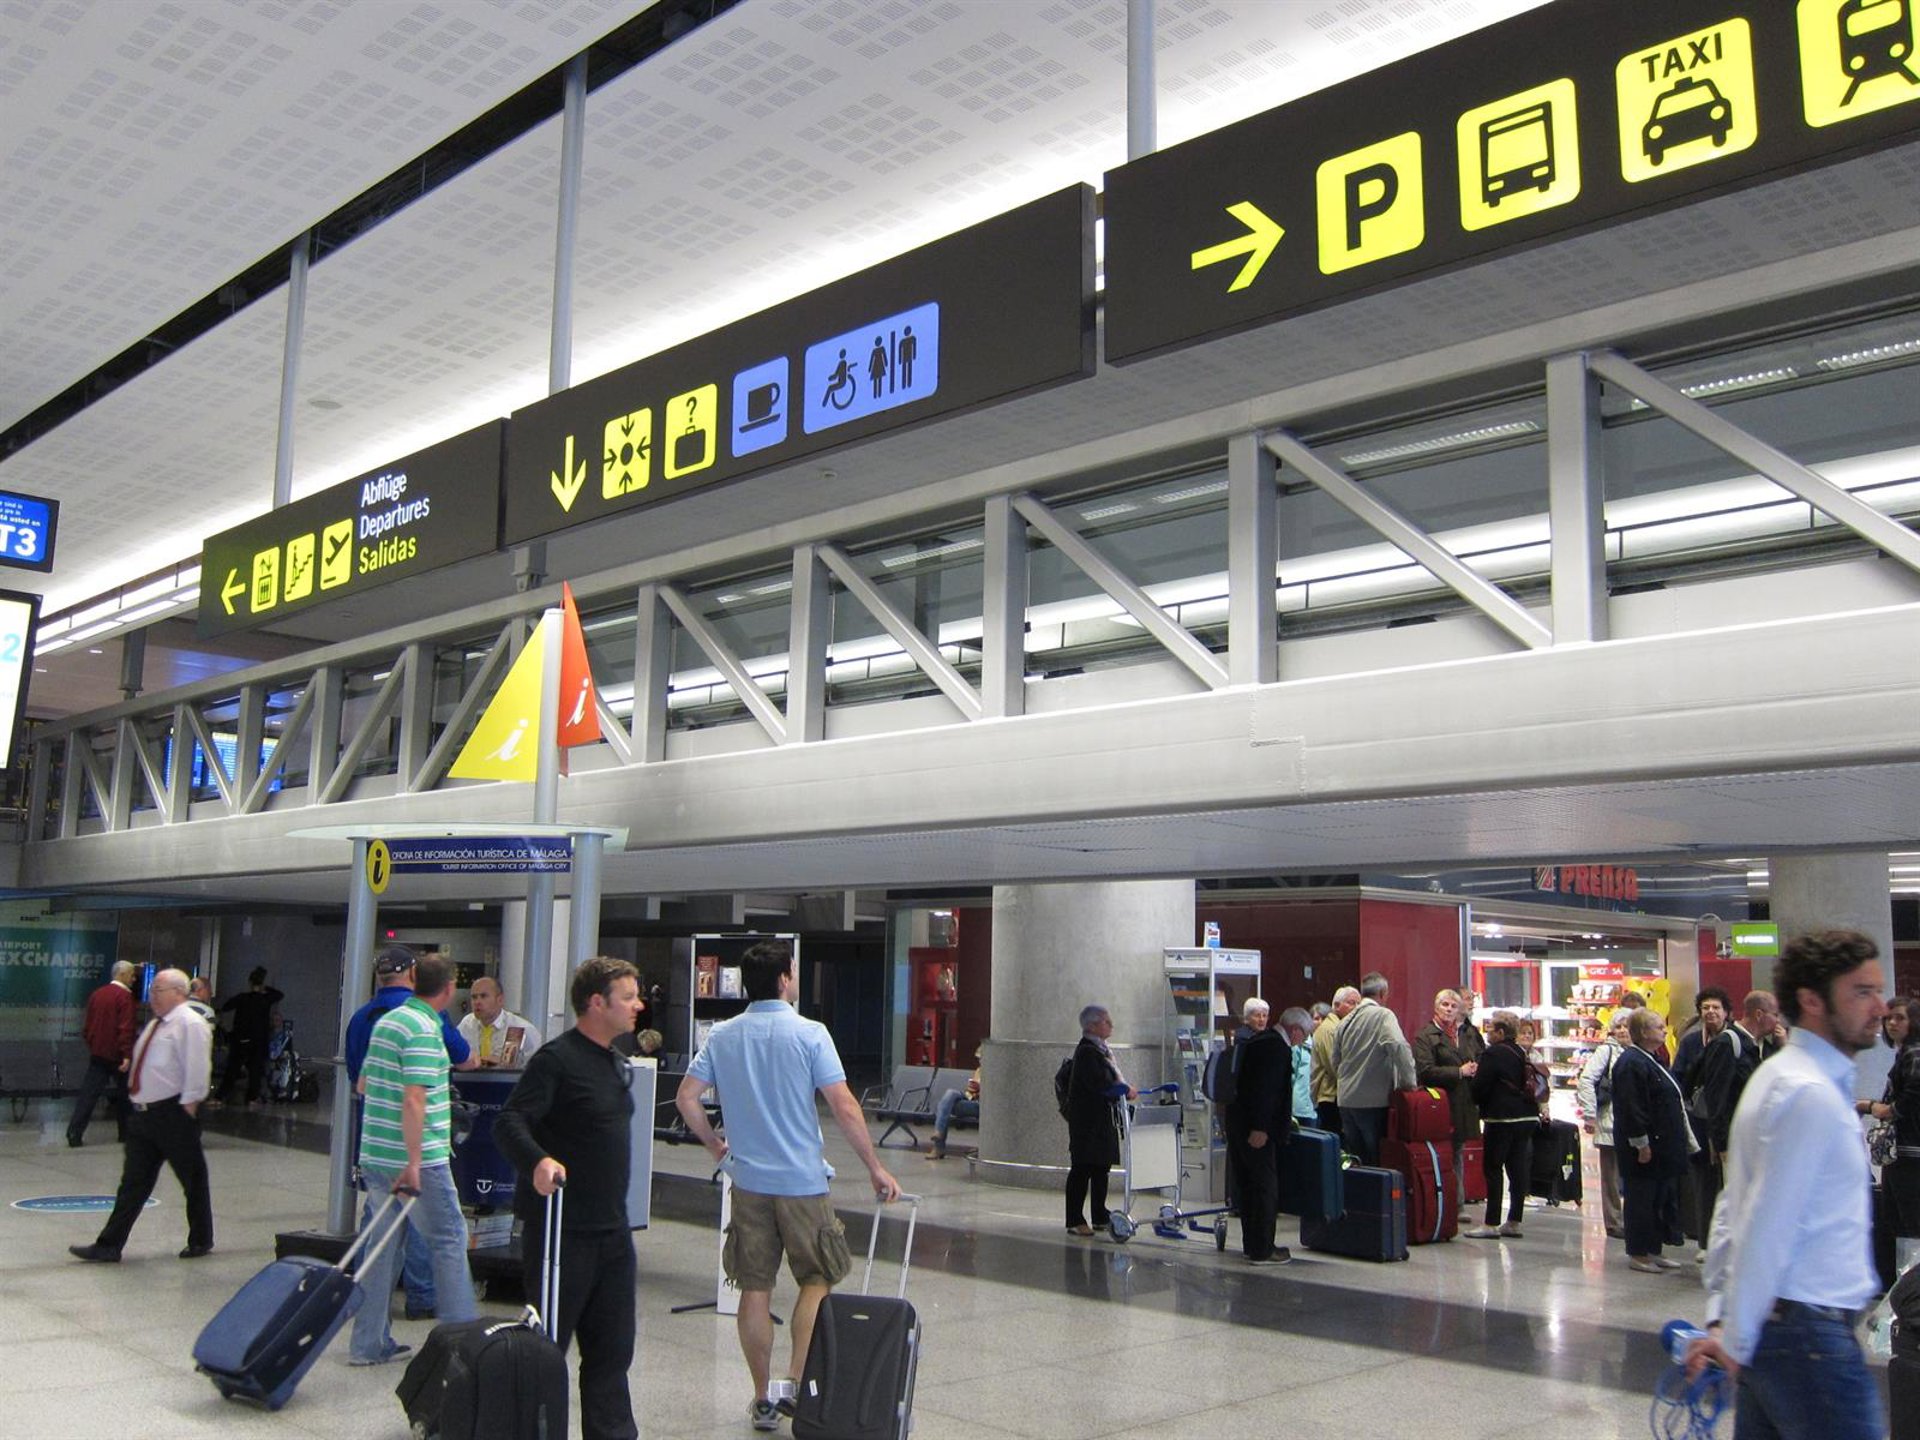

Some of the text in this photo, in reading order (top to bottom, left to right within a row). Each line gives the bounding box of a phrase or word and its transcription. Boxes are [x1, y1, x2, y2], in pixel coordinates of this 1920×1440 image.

[1641, 31, 1723, 83] TAXI
[1345, 162, 1399, 252] P
[361, 474, 407, 508] Abflüge
[360, 497, 430, 540] Departures
[0, 524, 37, 557] T3
[359, 536, 416, 574] Salidas
[424, 848, 476, 859] INFORMACIÓN
[477, 847, 515, 859] TURÍSTICA
[516, 849, 528, 858] DE
[530, 846, 568, 859] MÁLAGA
[0, 951, 105, 967] EXCHANGE
